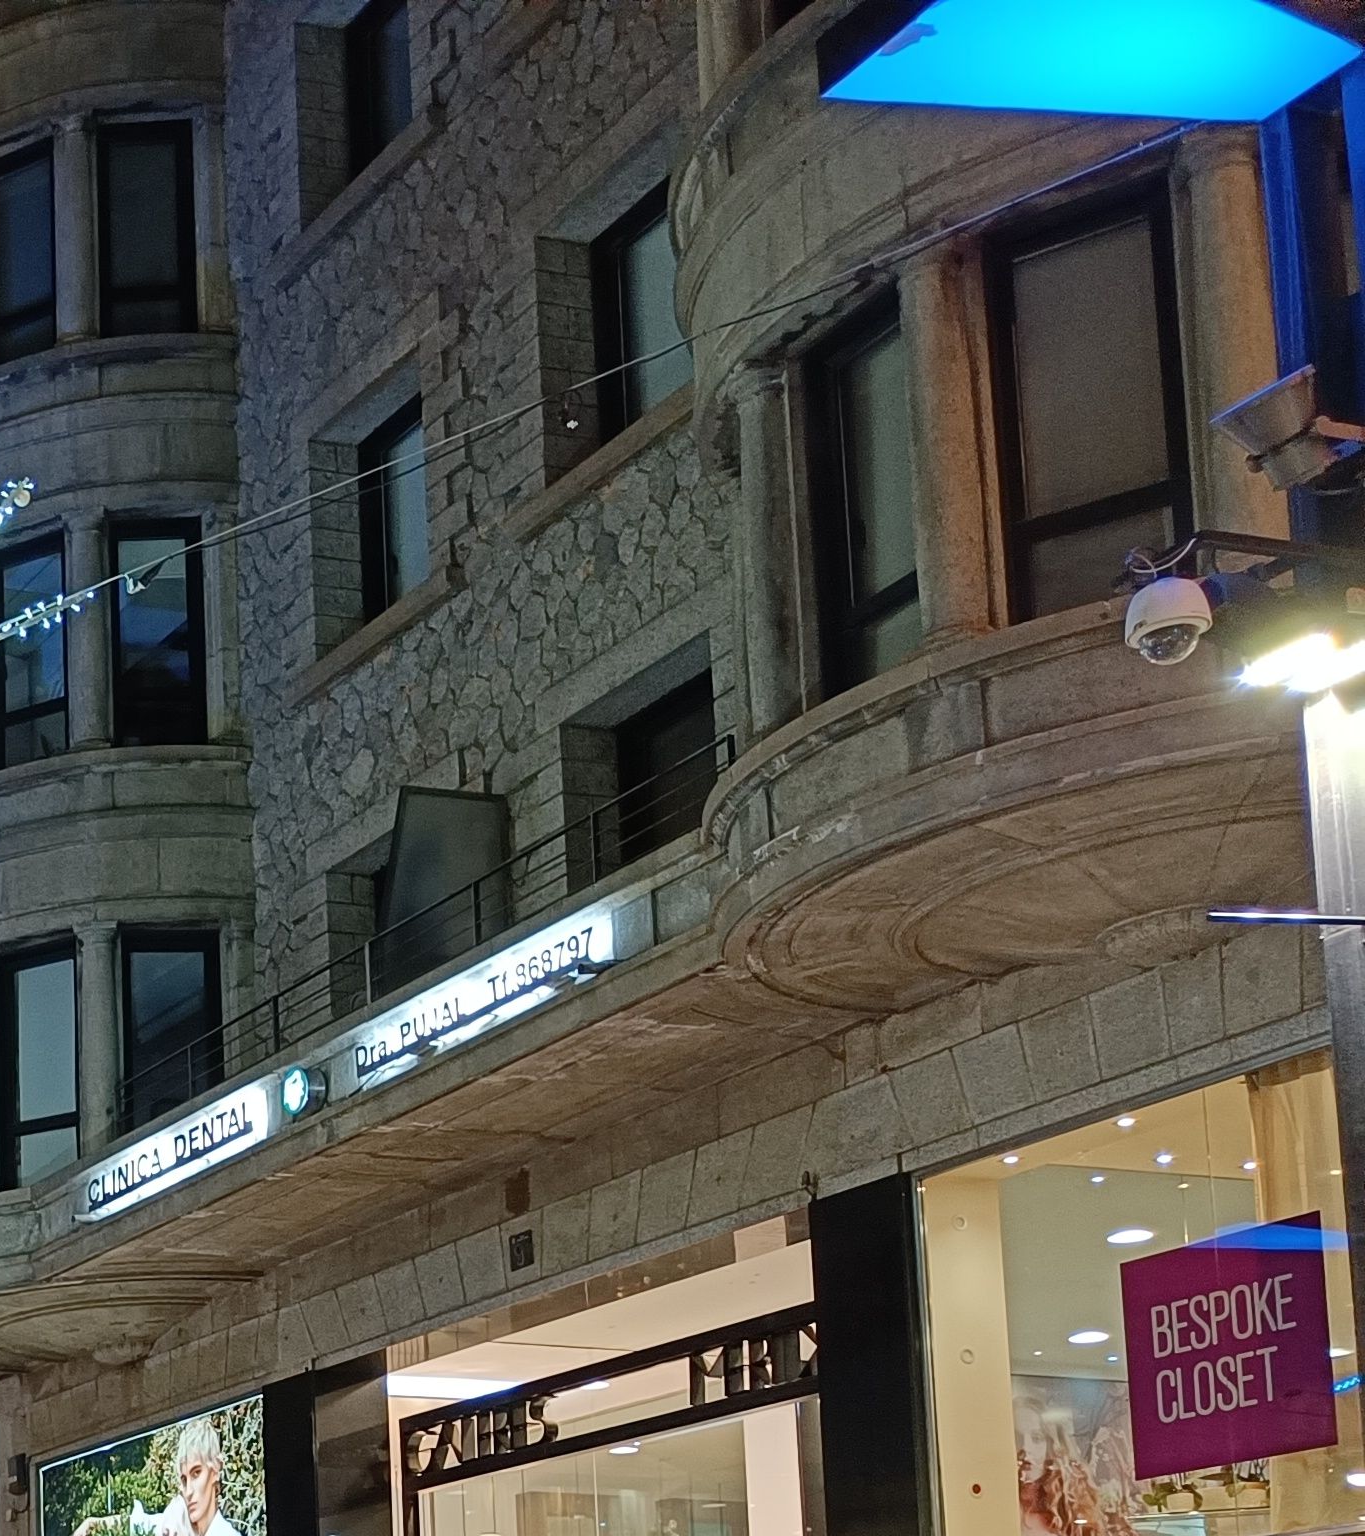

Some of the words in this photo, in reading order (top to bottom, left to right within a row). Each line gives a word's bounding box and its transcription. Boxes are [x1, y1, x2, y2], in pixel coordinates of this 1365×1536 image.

[87, 1147, 163, 1206] CLINICA
[173, 1101, 254, 1163] DENTAL
[1150, 1273, 1297, 1359] BESPOKE
[1155, 1346, 1278, 1424] CLOSET
